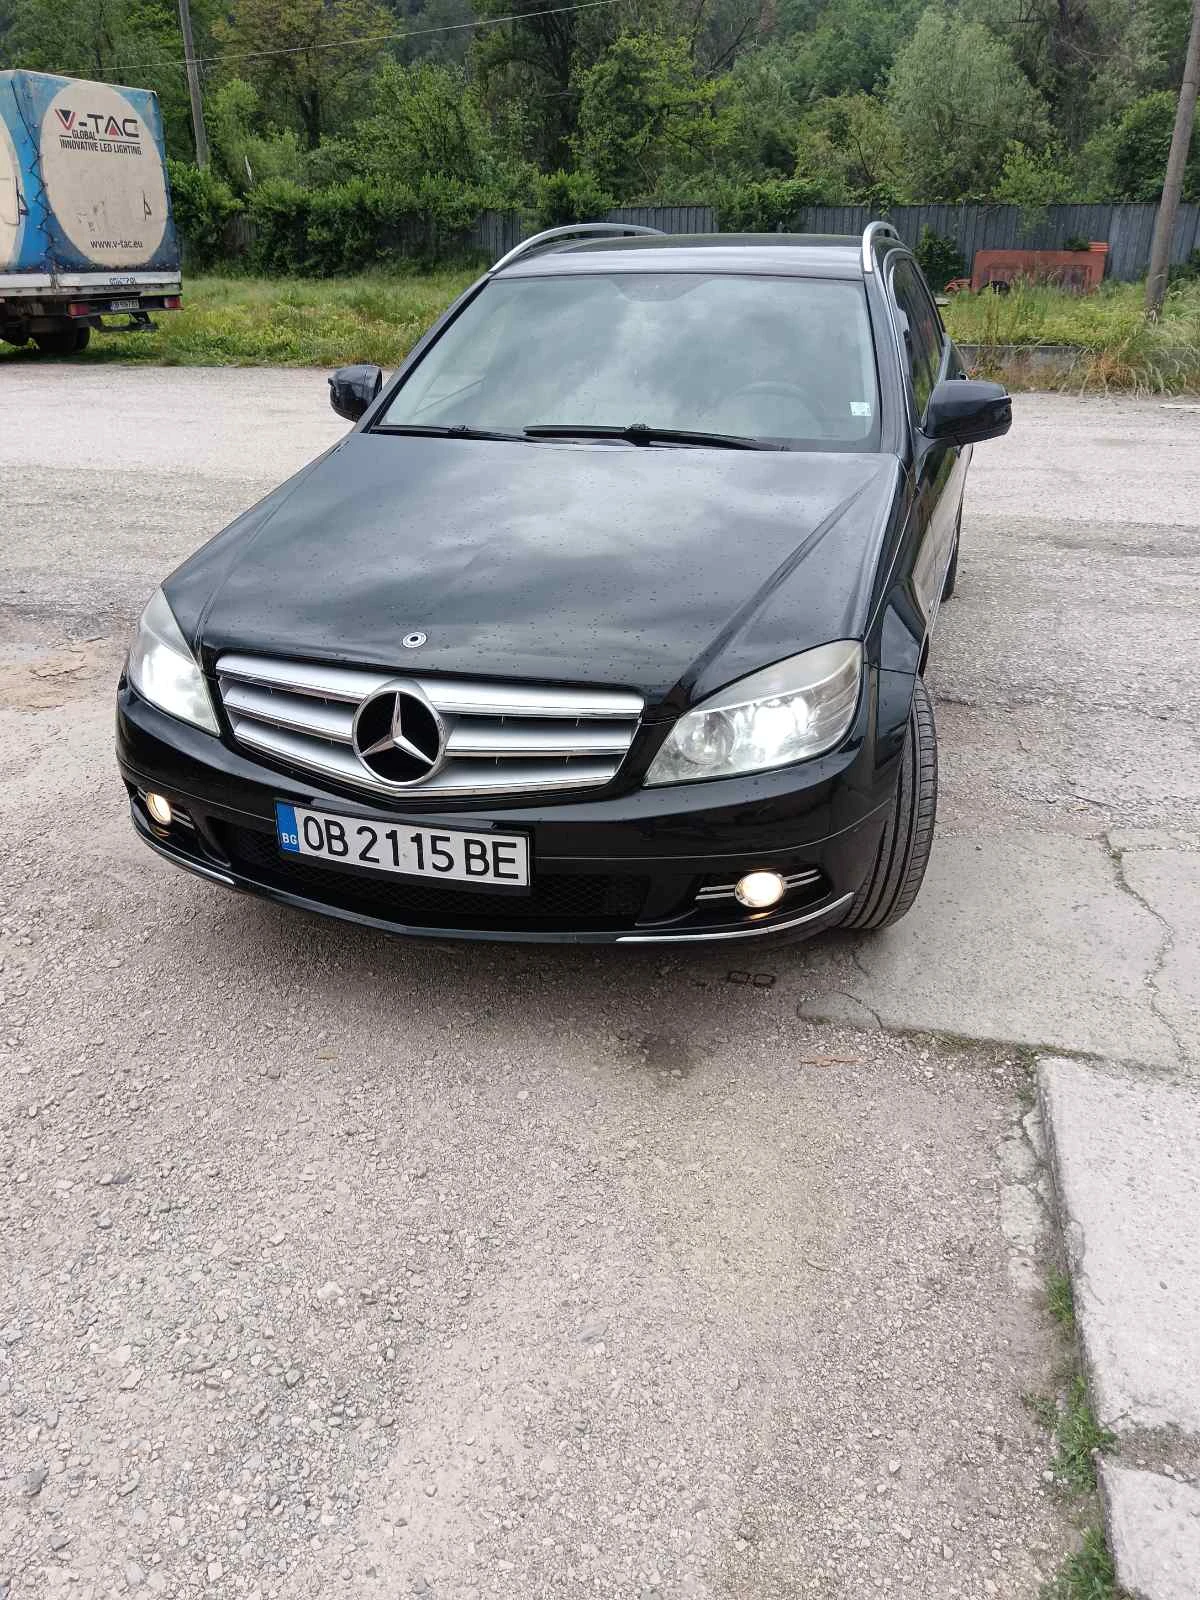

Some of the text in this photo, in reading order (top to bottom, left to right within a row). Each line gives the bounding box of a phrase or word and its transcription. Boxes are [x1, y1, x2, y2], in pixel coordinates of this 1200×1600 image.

[54, 108, 140, 138] V-TAC
[72, 129, 98, 141] GLOBAL
[59, 139, 142, 155] INNOVATIVE LED LIGHTING
[90, 240, 144, 248] www.v-tac.eu
[281, 832, 298, 845] BG
[356, 825, 455, 872] 2115
